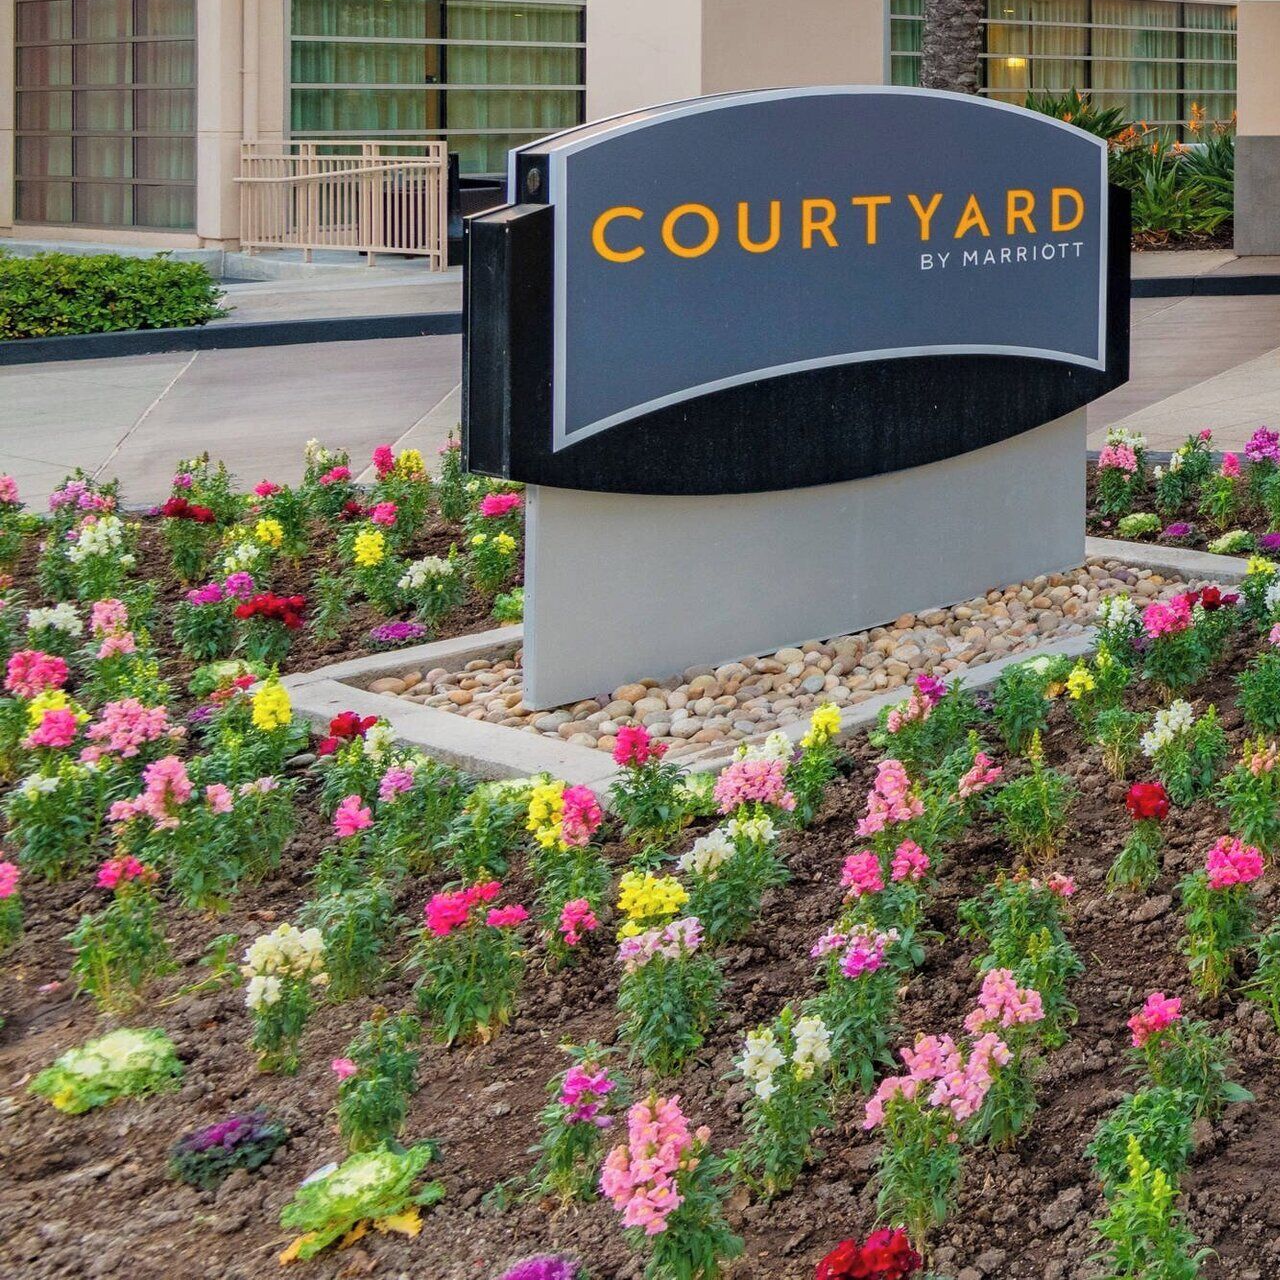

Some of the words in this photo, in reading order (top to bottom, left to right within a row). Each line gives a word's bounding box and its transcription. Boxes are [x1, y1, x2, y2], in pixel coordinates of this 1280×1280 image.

[590, 186, 1086, 263] COURTYARD
[920, 252, 951, 271] BY
[963, 242, 1084, 267] MARRIOTT
